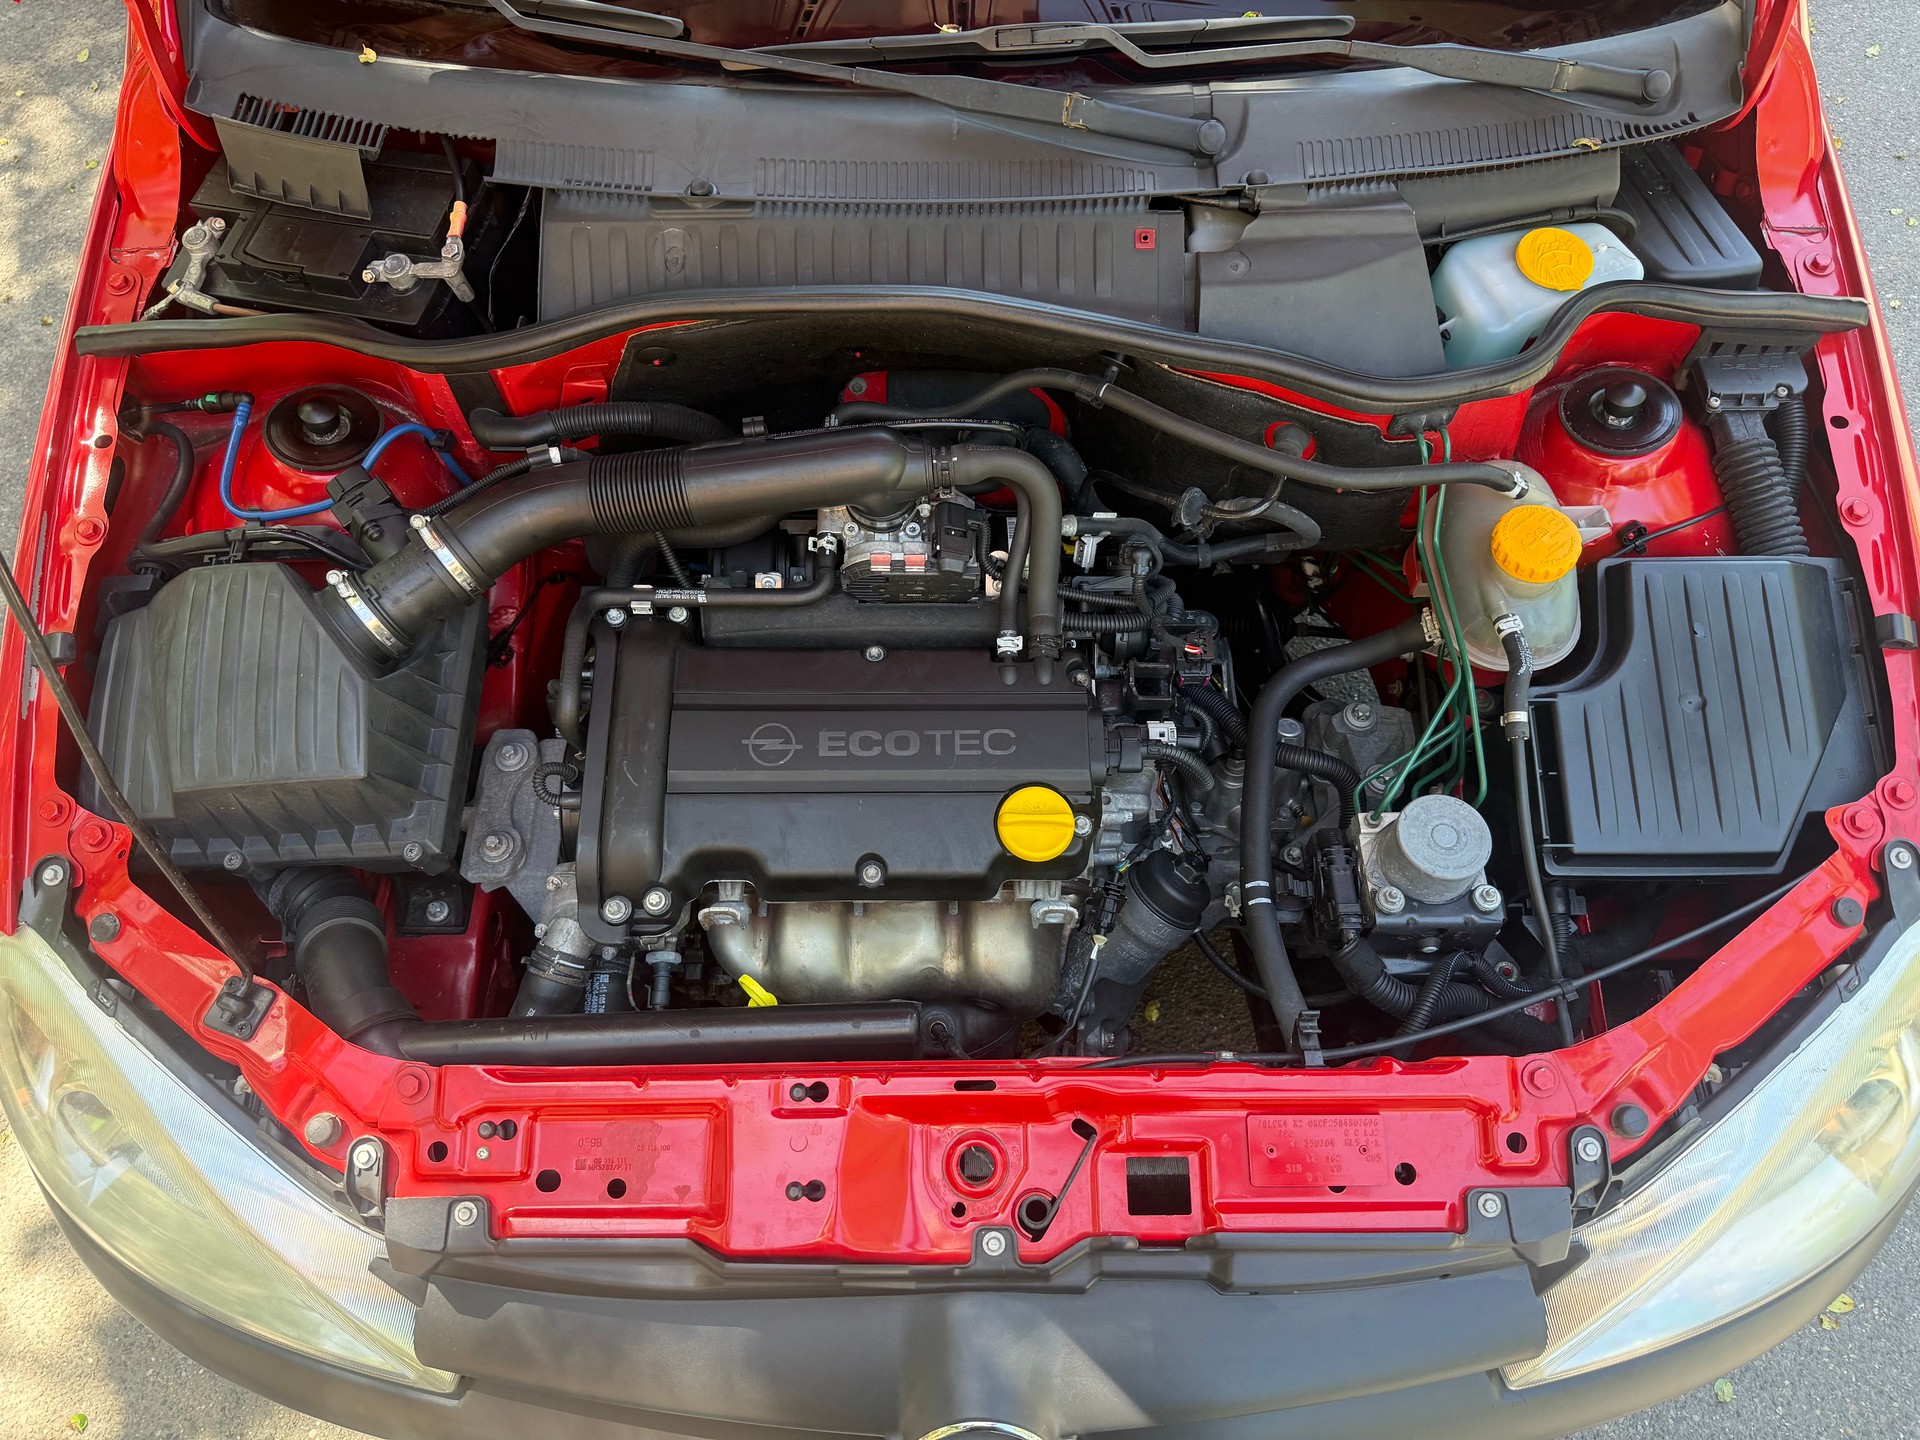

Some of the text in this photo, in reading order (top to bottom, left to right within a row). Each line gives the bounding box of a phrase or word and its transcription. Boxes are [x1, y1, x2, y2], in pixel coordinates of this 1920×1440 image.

[817, 728, 1017, 757] ECOTEC
[578, 1137, 602, 1148] 0598
[660, 1144, 671, 1152] 109
